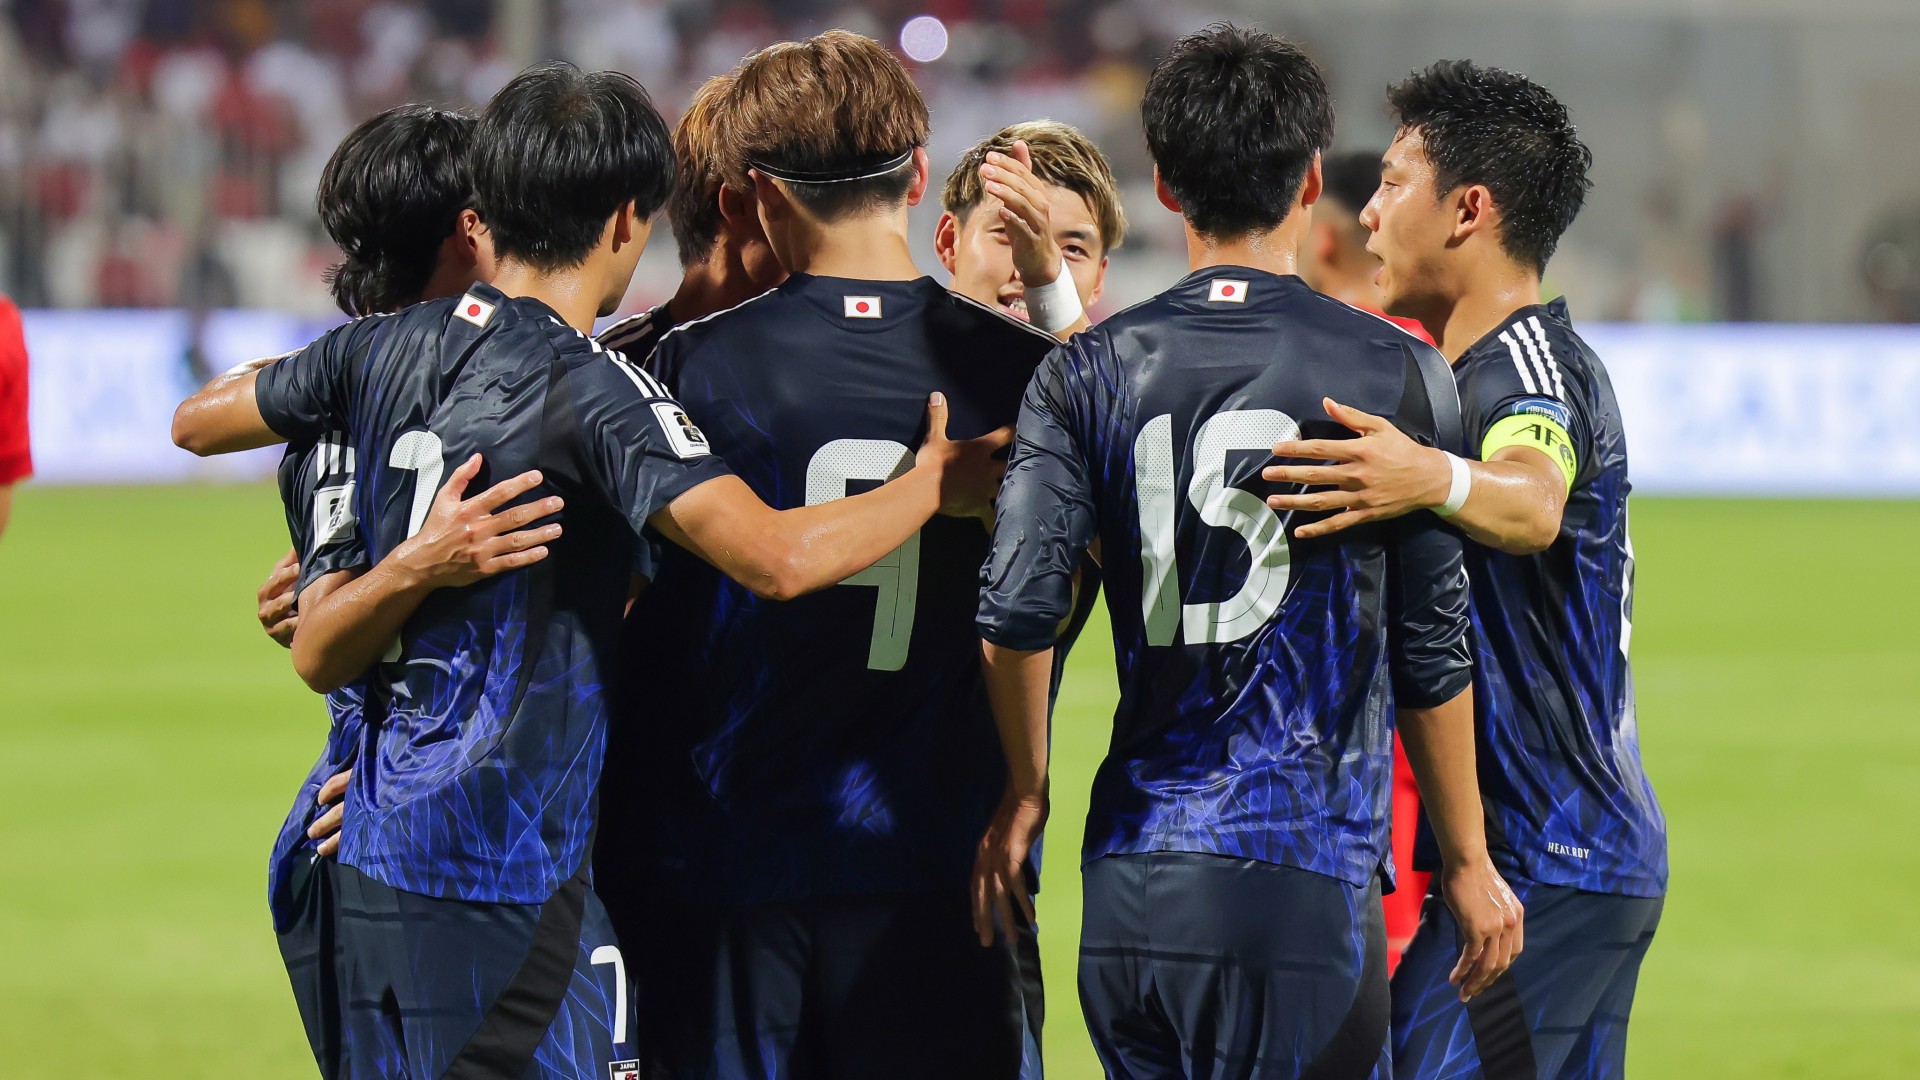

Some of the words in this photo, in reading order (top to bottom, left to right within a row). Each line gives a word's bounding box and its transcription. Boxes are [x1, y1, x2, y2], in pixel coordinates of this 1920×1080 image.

[805, 438, 921, 671] 9
[1134, 408, 1302, 647] 15
[590, 945, 627, 1044] 7
